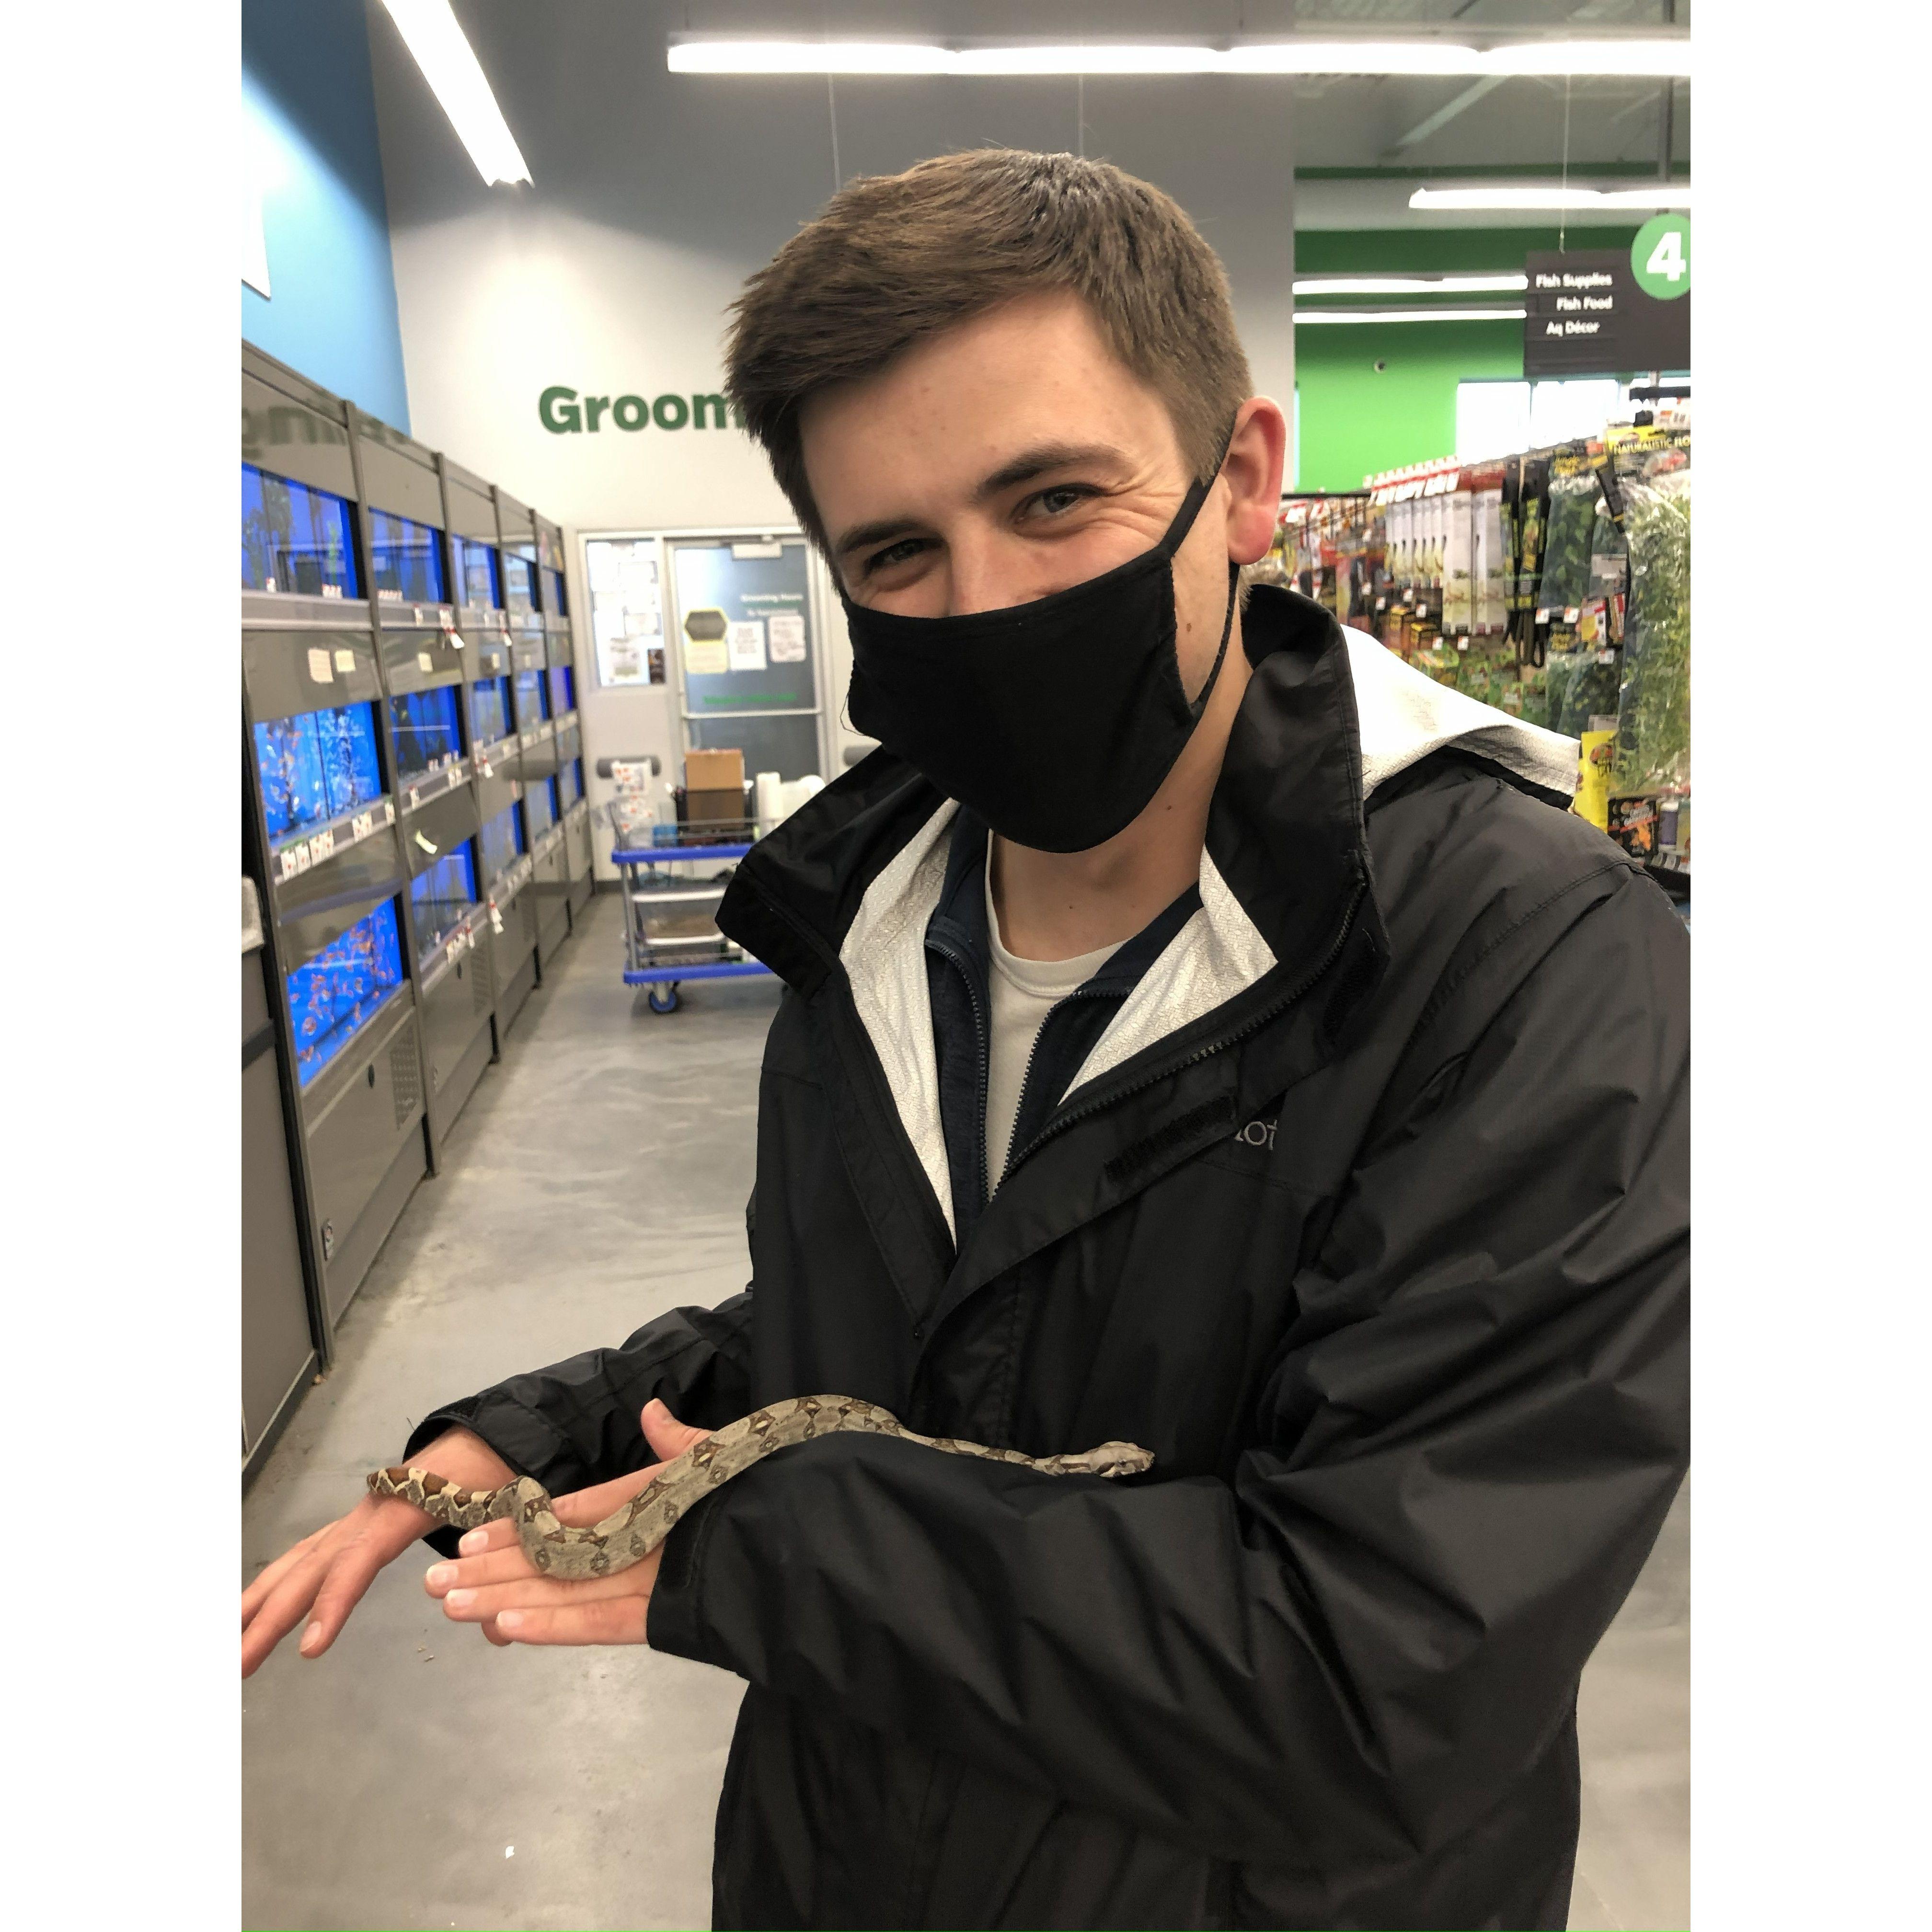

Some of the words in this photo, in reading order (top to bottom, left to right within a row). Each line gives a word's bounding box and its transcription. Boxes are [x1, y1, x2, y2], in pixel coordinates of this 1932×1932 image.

[1646, 231, 1687, 281] 4
[1536, 273, 1561, 288] Fish
[1563, 272, 1613, 290] Supplies
[1556, 296, 1581, 311] Fish
[1583, 295, 1613, 310] Food
[1546, 321, 1563, 337] Aq
[1565, 320, 1600, 334] Décor
